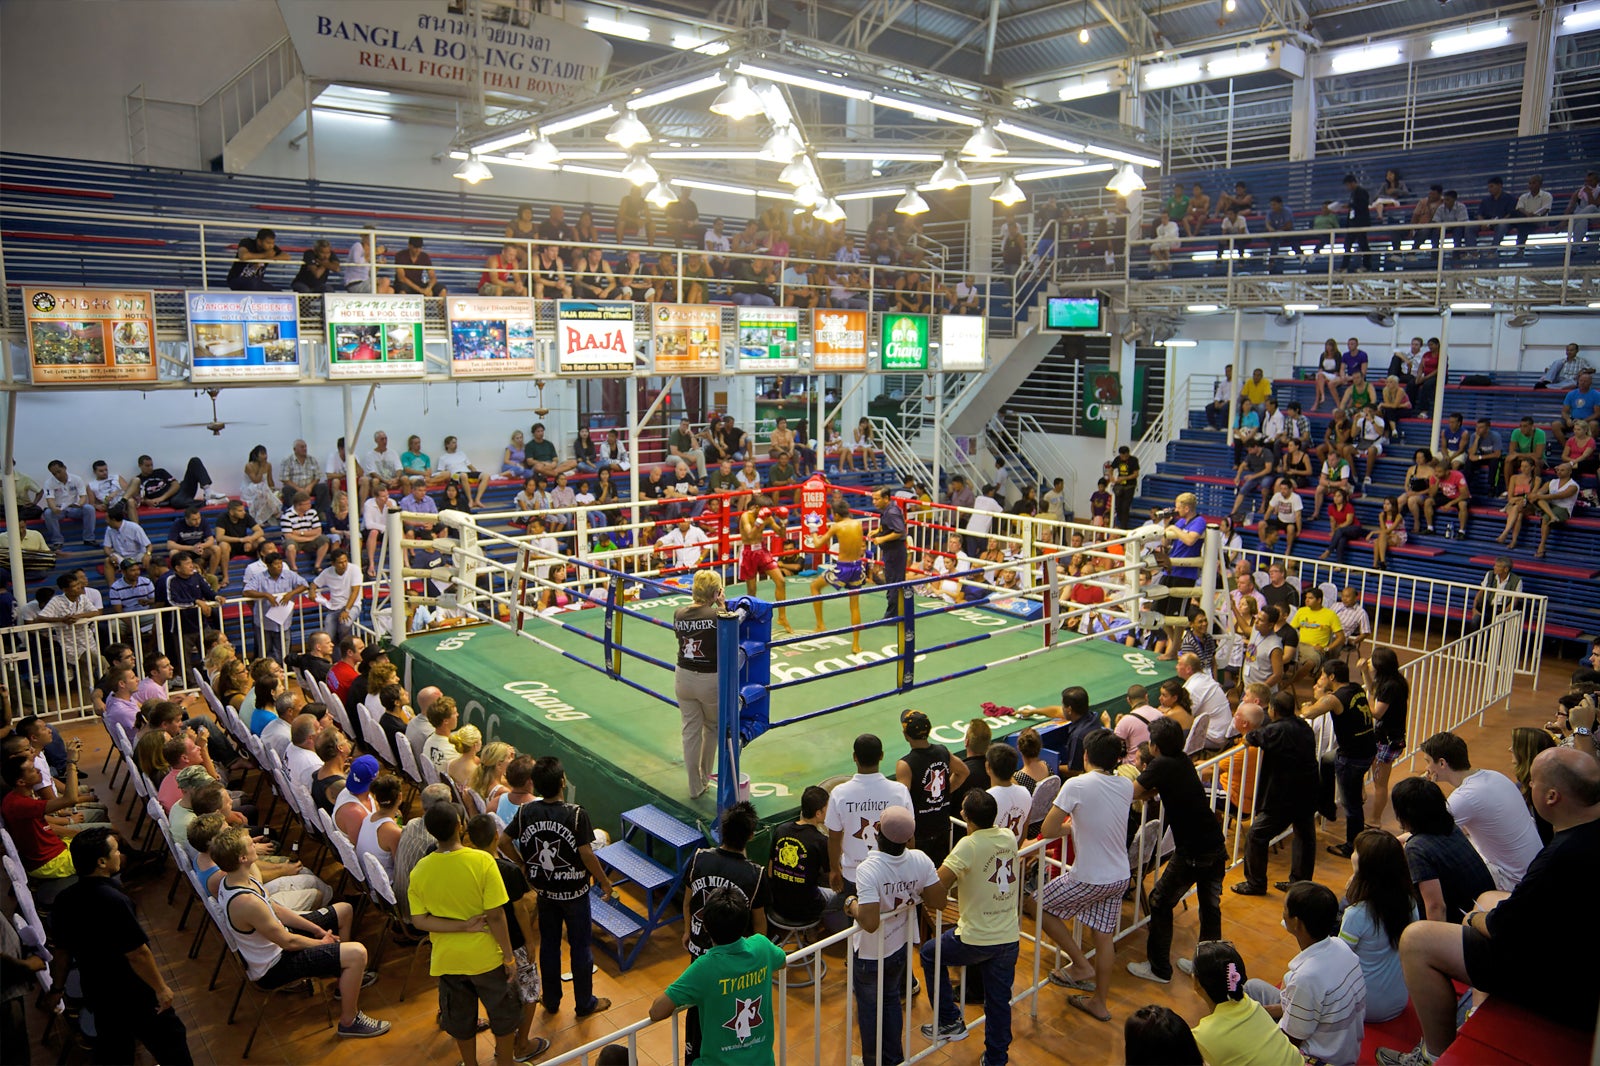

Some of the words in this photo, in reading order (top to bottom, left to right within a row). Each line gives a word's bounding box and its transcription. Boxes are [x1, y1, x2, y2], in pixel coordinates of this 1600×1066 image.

[316, 15, 425, 54] BANGLA
[358, 51, 410, 73] REAL
[483, 71, 521, 90] THAI
[114, 299, 146, 312] INN
[566, 325, 627, 355] RAJA
[885, 341, 923, 362] Chang
[802, 492, 825, 503] TIGER
[502, 680, 593, 721] Chang
[546, 883, 590, 901] THAILAND
[718, 965, 768, 995] Trainer
